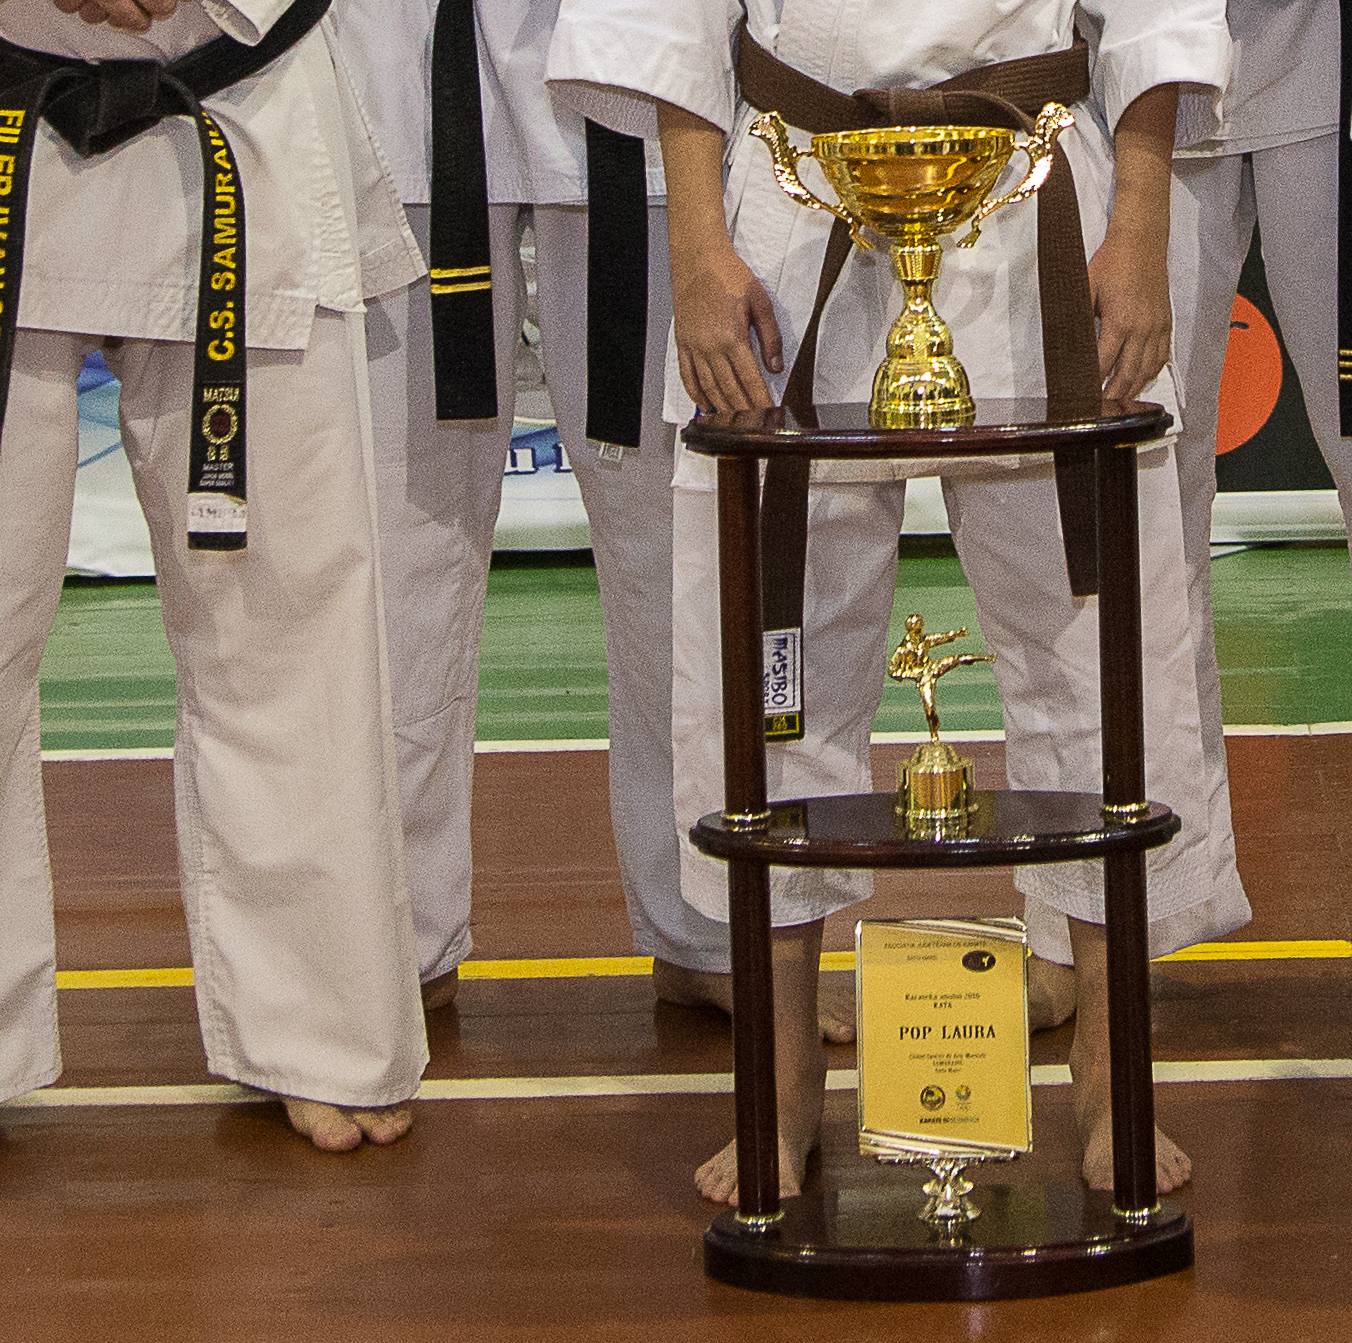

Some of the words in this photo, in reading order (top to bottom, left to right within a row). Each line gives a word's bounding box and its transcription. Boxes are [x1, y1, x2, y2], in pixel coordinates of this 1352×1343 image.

[207, 300, 237, 362] C.S.
[771, 636, 789, 706] MASIBO
[899, 1025, 933, 1041] POP
[941, 1024, 997, 1040] LAURA
